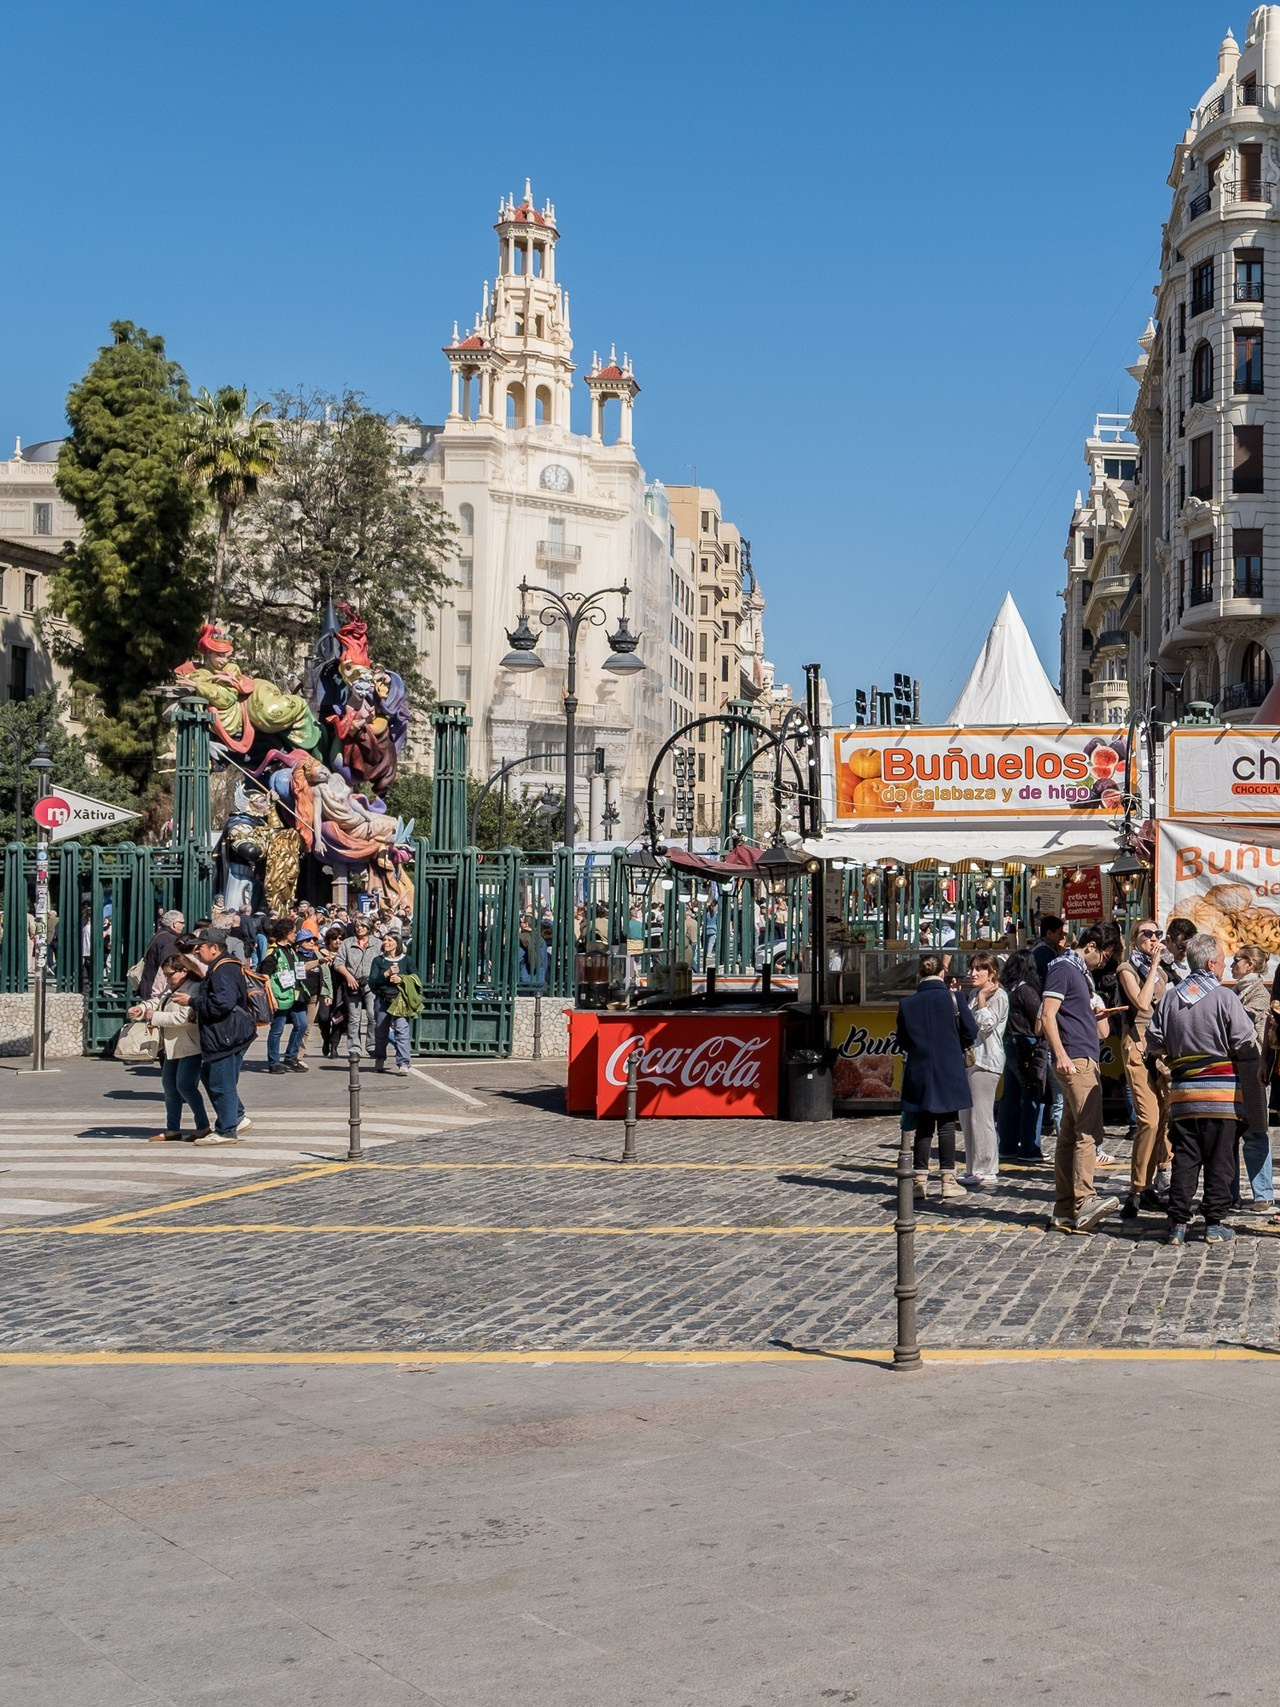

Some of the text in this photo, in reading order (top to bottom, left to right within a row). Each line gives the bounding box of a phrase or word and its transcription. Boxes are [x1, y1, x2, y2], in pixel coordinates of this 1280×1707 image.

[882, 745, 1090, 782] Buñuelos
[882, 784, 1090, 803] de calabaza y de higo
[73, 808, 116, 820] Xàtiva
[604, 1034, 771, 1088] Coca-Cola
